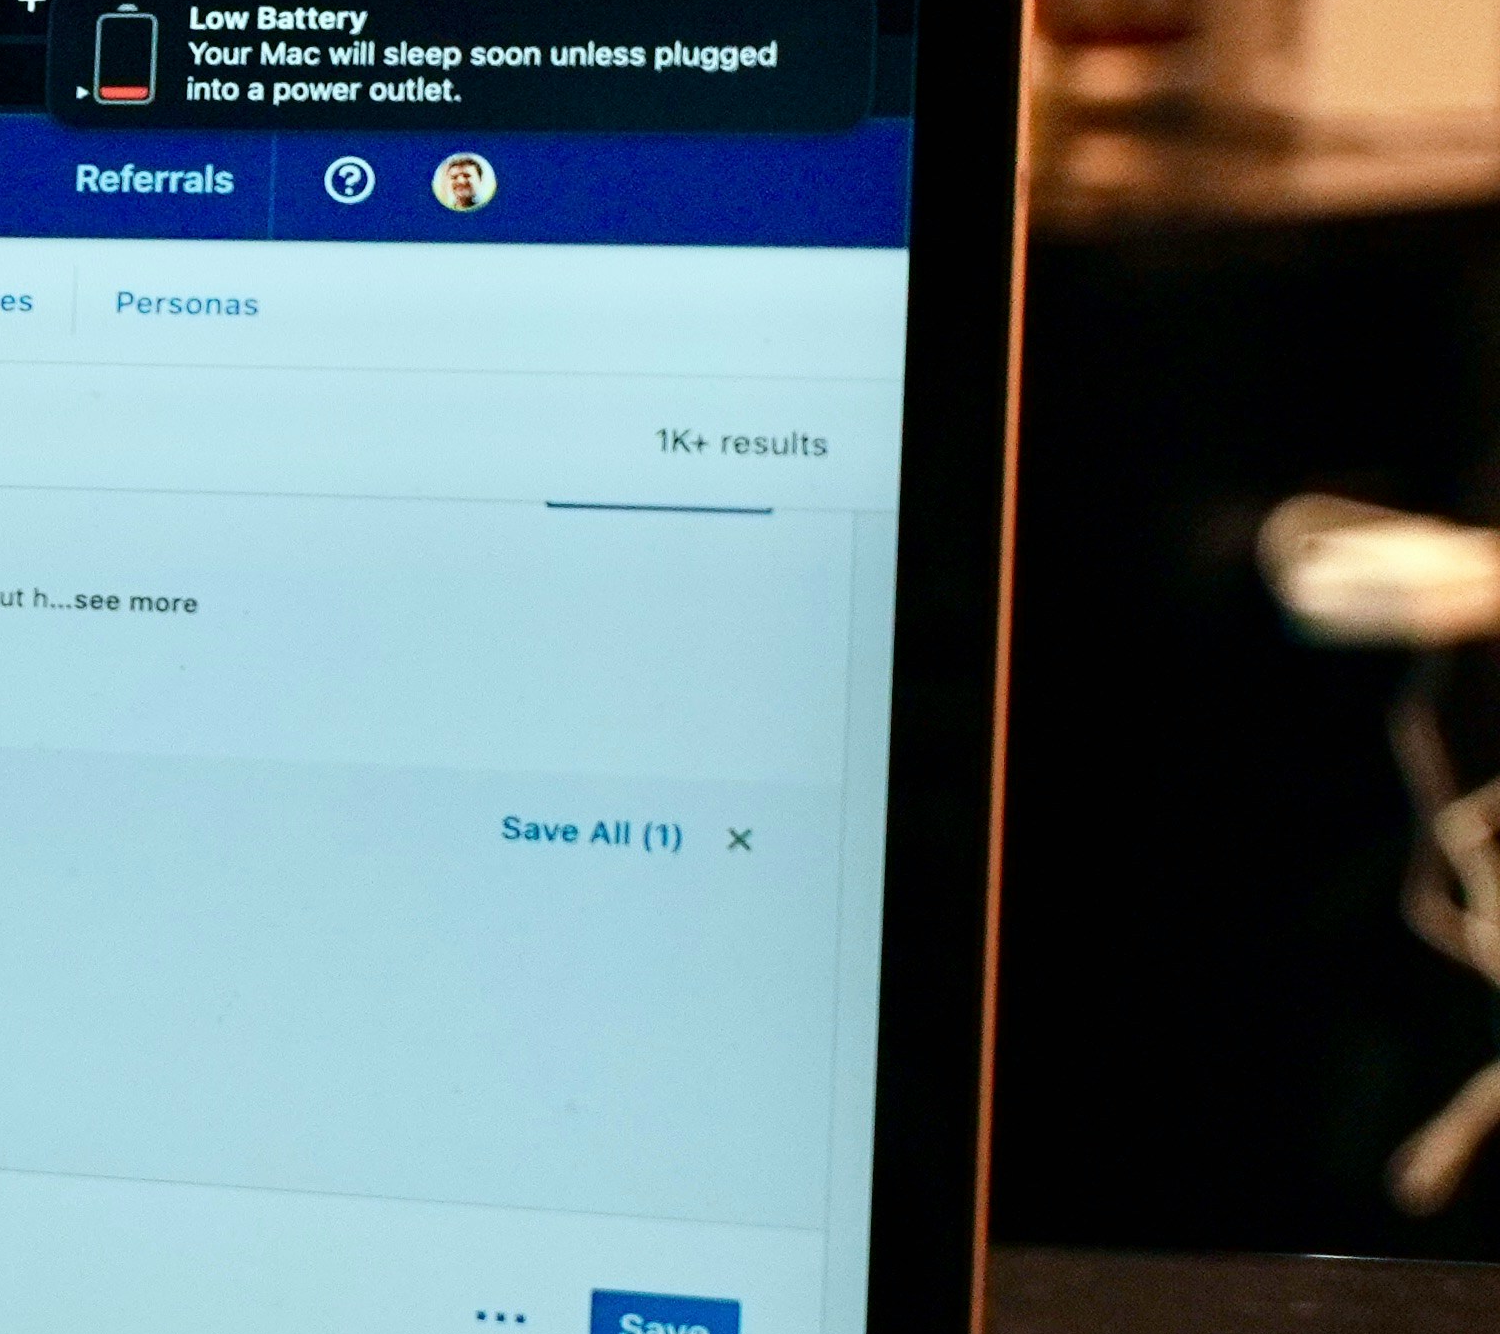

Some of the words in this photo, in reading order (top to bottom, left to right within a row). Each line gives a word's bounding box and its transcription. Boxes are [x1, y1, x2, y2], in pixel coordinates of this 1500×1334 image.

[189, 5, 250, 31] Low
[256, 5, 369, 36] Battery
[187, 40, 254, 66] Your
[259, 40, 321, 67] Mac
[328, 40, 376, 67] will
[382, 40, 463, 71] sleep
[469, 45, 542, 67] soon
[549, 40, 647, 68] unless
[653, 39, 778, 73] plugged
[186, 75, 240, 102] into
[247, 81, 265, 102] a
[272, 81, 363, 107] power
[368, 75, 462, 103] outlet.
[75, 162, 235, 195] Referrals
[116, 290, 260, 317] Personas
[656, 428, 709, 454] 1K+
[721, 430, 829, 458] results
[501, 815, 579, 844] Save
[589, 820, 631, 847] All
[642, 821, 683, 853] (1)
